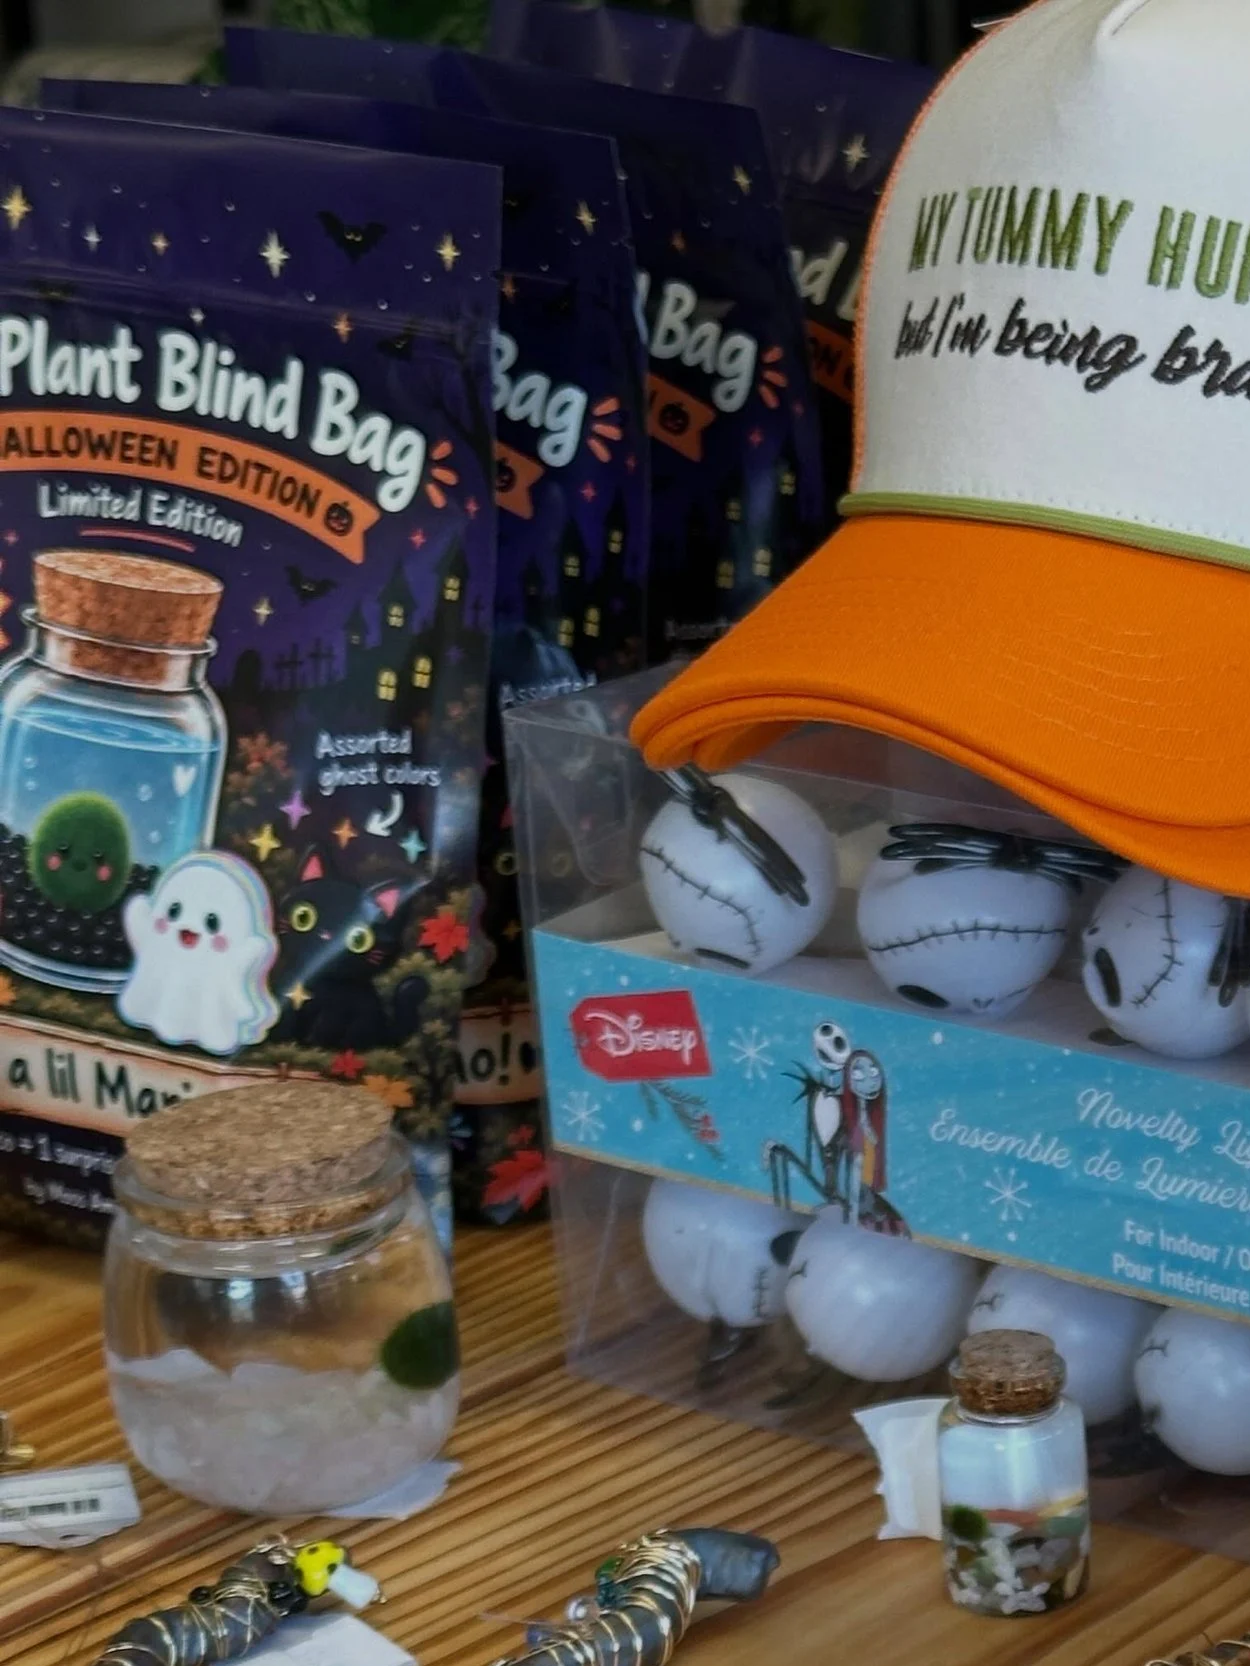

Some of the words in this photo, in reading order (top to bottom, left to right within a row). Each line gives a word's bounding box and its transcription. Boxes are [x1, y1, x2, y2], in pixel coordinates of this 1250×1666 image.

[908, 194, 958, 273] MY
[955, 186, 1134, 276] TUMMY
[649, 280, 758, 413] Bag
[895, 301, 939, 359] but
[993, 298, 1146, 393] being
[0, 316, 142, 403] Plant
[156, 330, 303, 439] Blind
[309, 369, 426, 512] Bag
[0, 424, 178, 470] ALLOWEEN
[195, 446, 322, 519] EDITION
[36, 481, 143, 521] Limited
[146, 489, 243, 548] Edition
[315, 726, 412, 759] Assorted
[318, 762, 378, 796] ghost
[383, 765, 442, 788] colors
[9, 1057, 35, 1092] a
[46, 1047, 81, 1103] lil
[929, 1107, 1072, 1170] Ensemble
[1084, 1149, 1124, 1181] de
[1076, 1088, 1201, 1153] Novelty
[1112, 1252, 1153, 1282] Pour
[1124, 1219, 1154, 1246] For
[1159, 1229, 1220, 1263] Indoor
